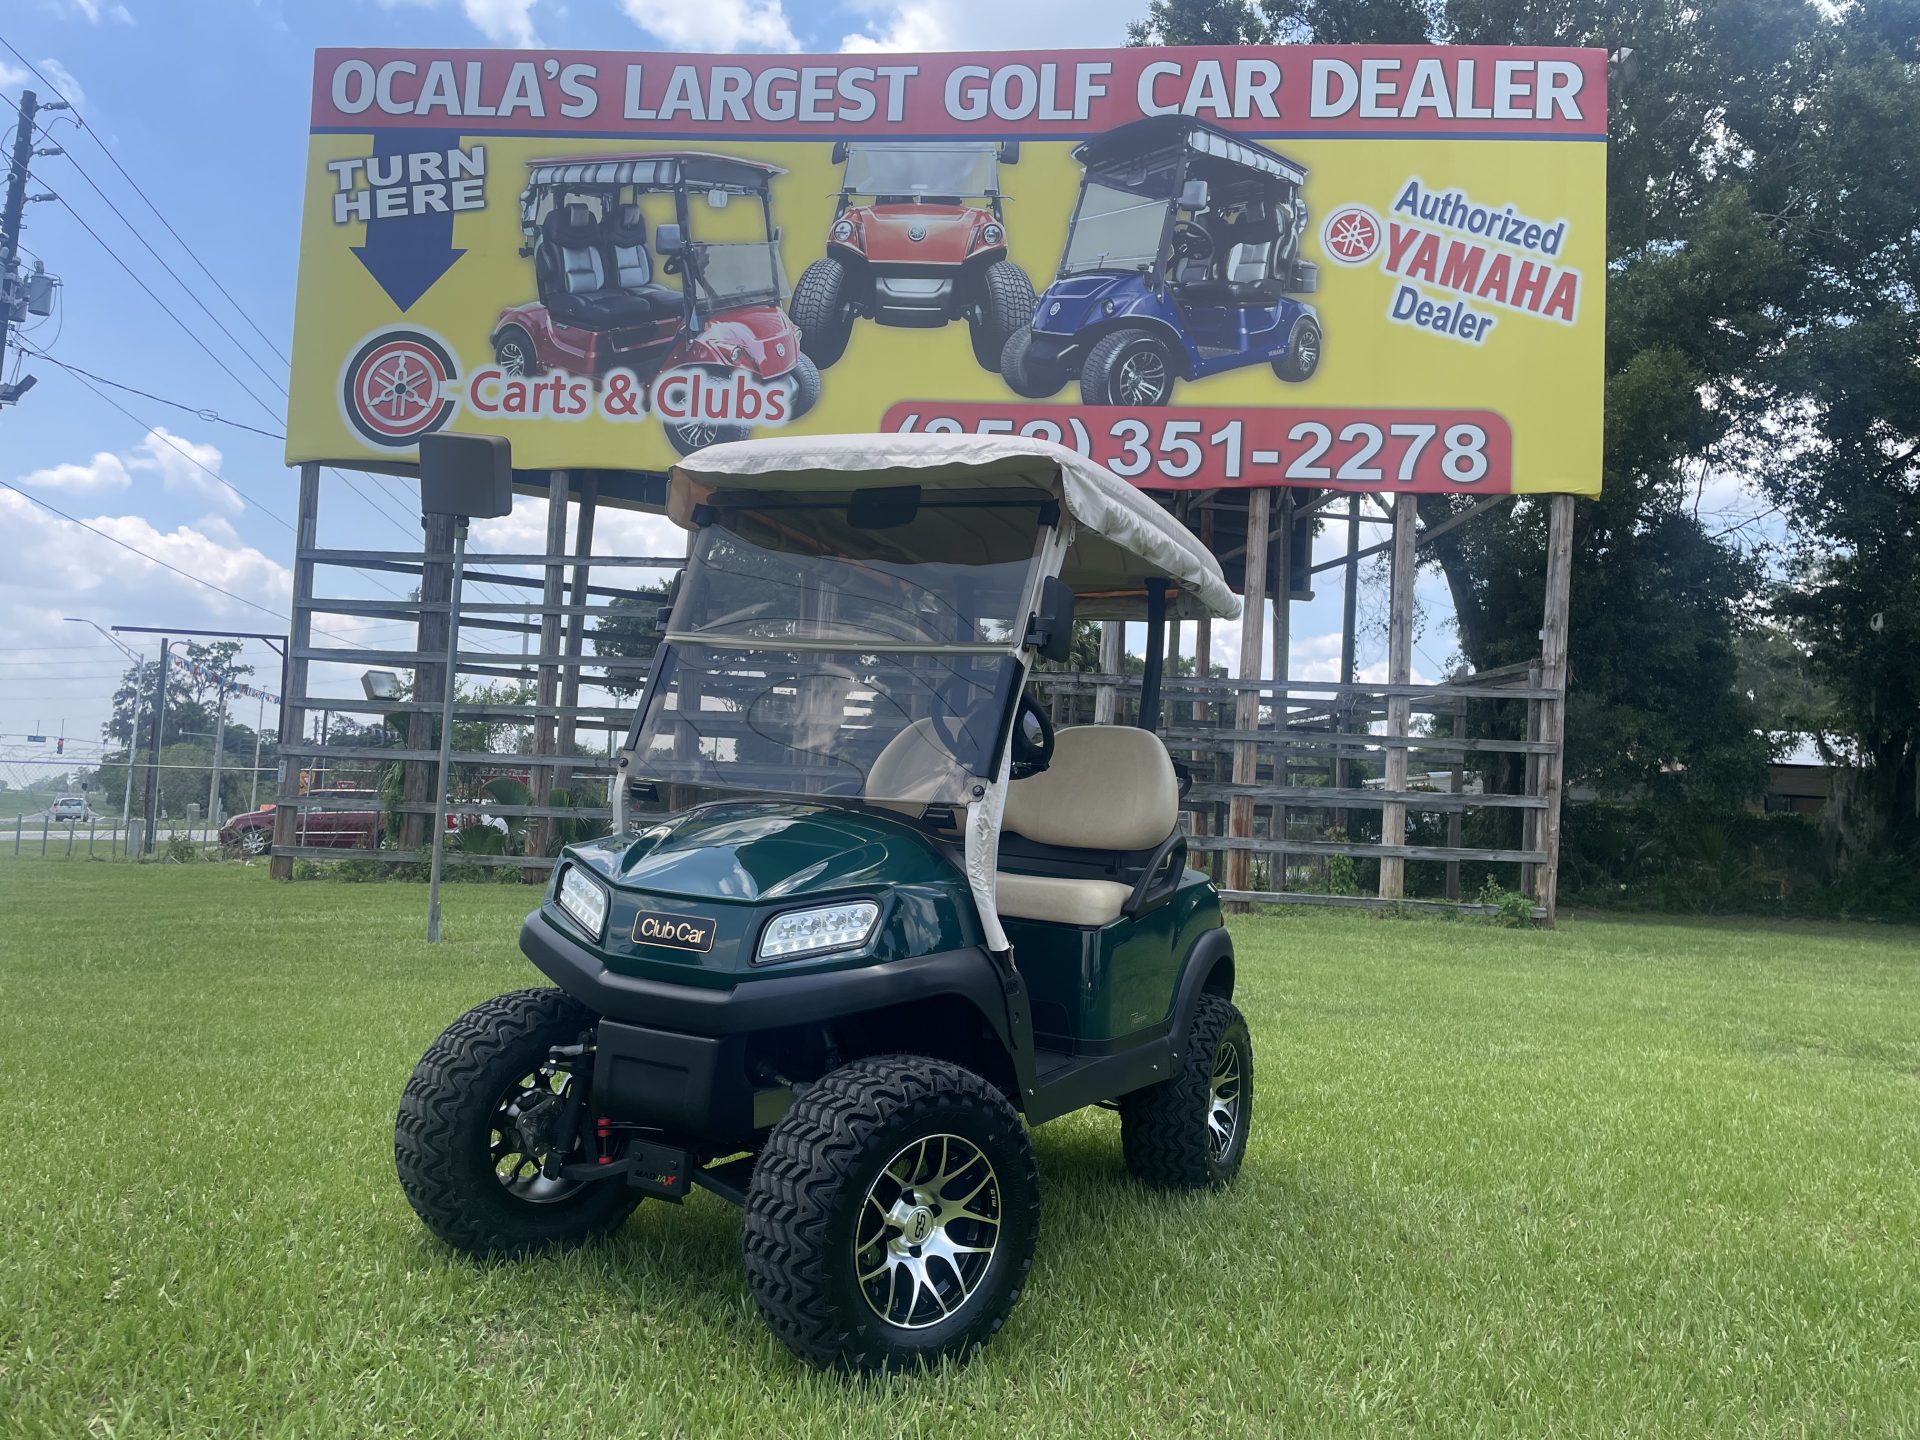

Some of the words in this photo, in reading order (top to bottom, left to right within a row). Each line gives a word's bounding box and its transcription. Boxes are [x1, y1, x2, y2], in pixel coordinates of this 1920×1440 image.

[331, 58, 598, 118] OCALA'S
[623, 64, 919, 122] LARGEST
[944, 61, 1112, 121] GOLF
[1137, 59, 1282, 118] CAR
[1310, 58, 1584, 120] DEALER
[328, 146, 485, 190] TURN
[334, 178, 485, 223] HERE
[1394, 180, 1565, 256] Authorized
[1385, 222, 1578, 322] YAMAHA
[1391, 285, 1493, 342] Dealer
[470, 370, 587, 415] Carts
[604, 374, 639, 416] &
[656, 374, 786, 422] Clubs
[1107, 418, 1489, 483] 351-2278
[641, 918, 676, 940] Club
[676, 922, 706, 944] Car
